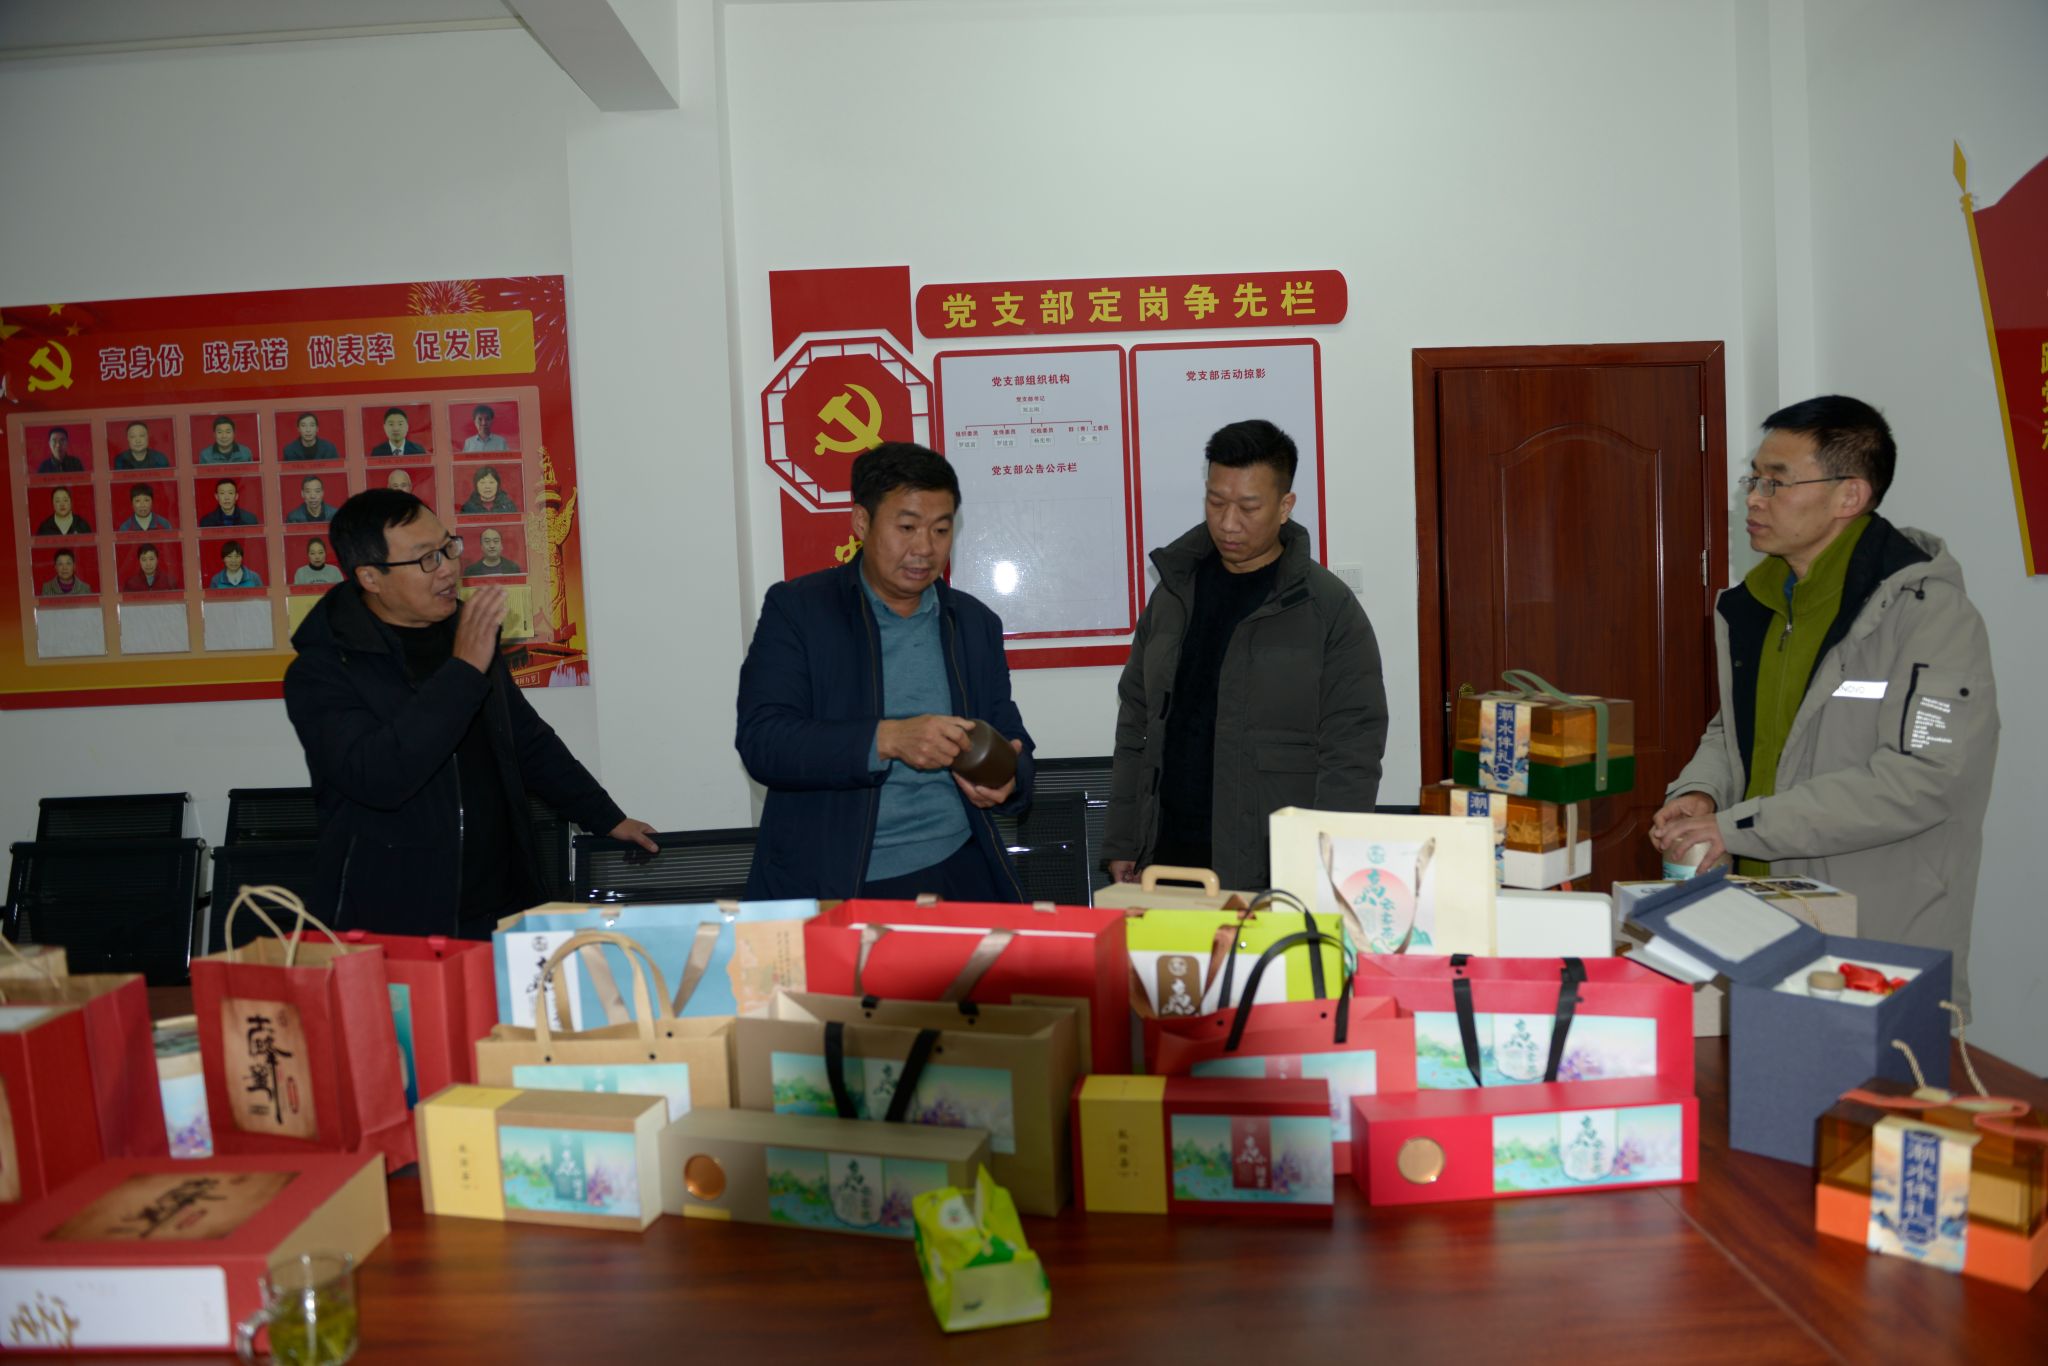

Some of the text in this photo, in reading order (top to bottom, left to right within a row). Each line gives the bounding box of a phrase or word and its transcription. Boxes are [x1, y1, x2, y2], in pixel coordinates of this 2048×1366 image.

[942, 281, 1316, 329] 党支部定岗争先栏
[100, 327, 501, 381] 亮身份 践承诺 做表率 促发展
[991, 373, 1070, 387] 党支部组织机构
[1186, 368, 1266, 381] 党支部活动掠影
[991, 462, 1078, 476] 党支部公告公示栏
